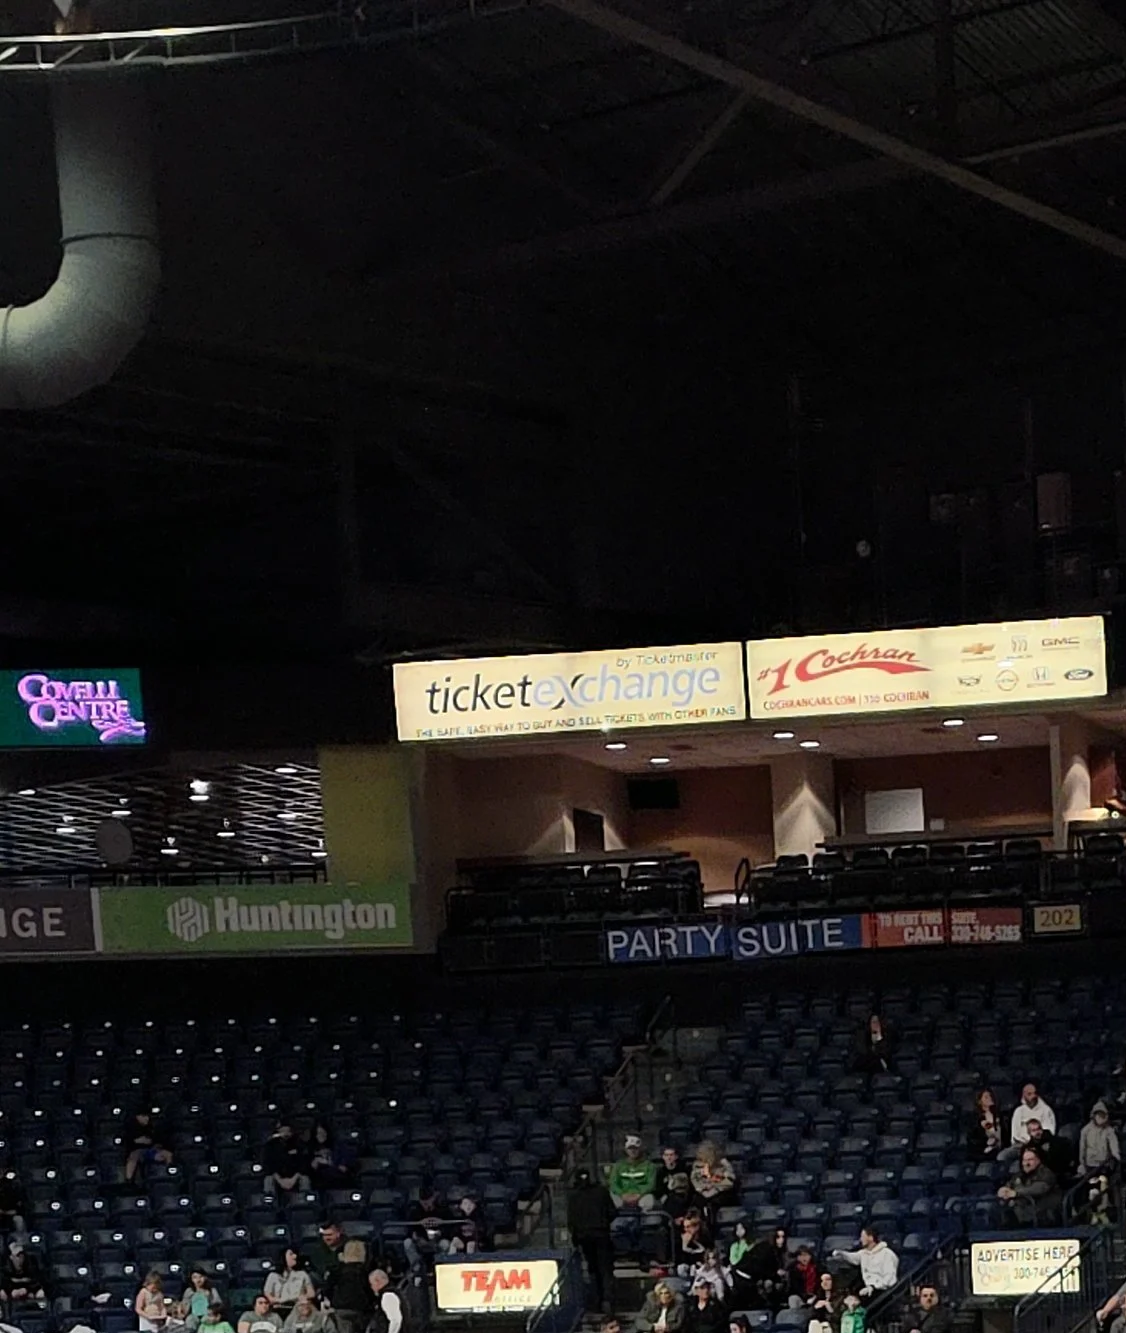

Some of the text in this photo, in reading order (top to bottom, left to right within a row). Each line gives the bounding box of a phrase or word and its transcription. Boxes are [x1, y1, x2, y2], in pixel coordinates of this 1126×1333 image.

[1041, 636, 1080, 647] GMC
[616, 651, 718, 669] by Ticketmaster
[795, 642, 922, 682] Cochran
[29, 700, 131, 730] CENTRE
[214, 897, 397, 940] Huntington
[1040, 910, 1074, 927] 202
[607, 917, 845, 961] PARTY SUITE
[903, 926, 944, 943] CALL
[977, 1246, 1074, 1262] ADVERTISE HERE
[461, 1269, 532, 1303] TEAM
